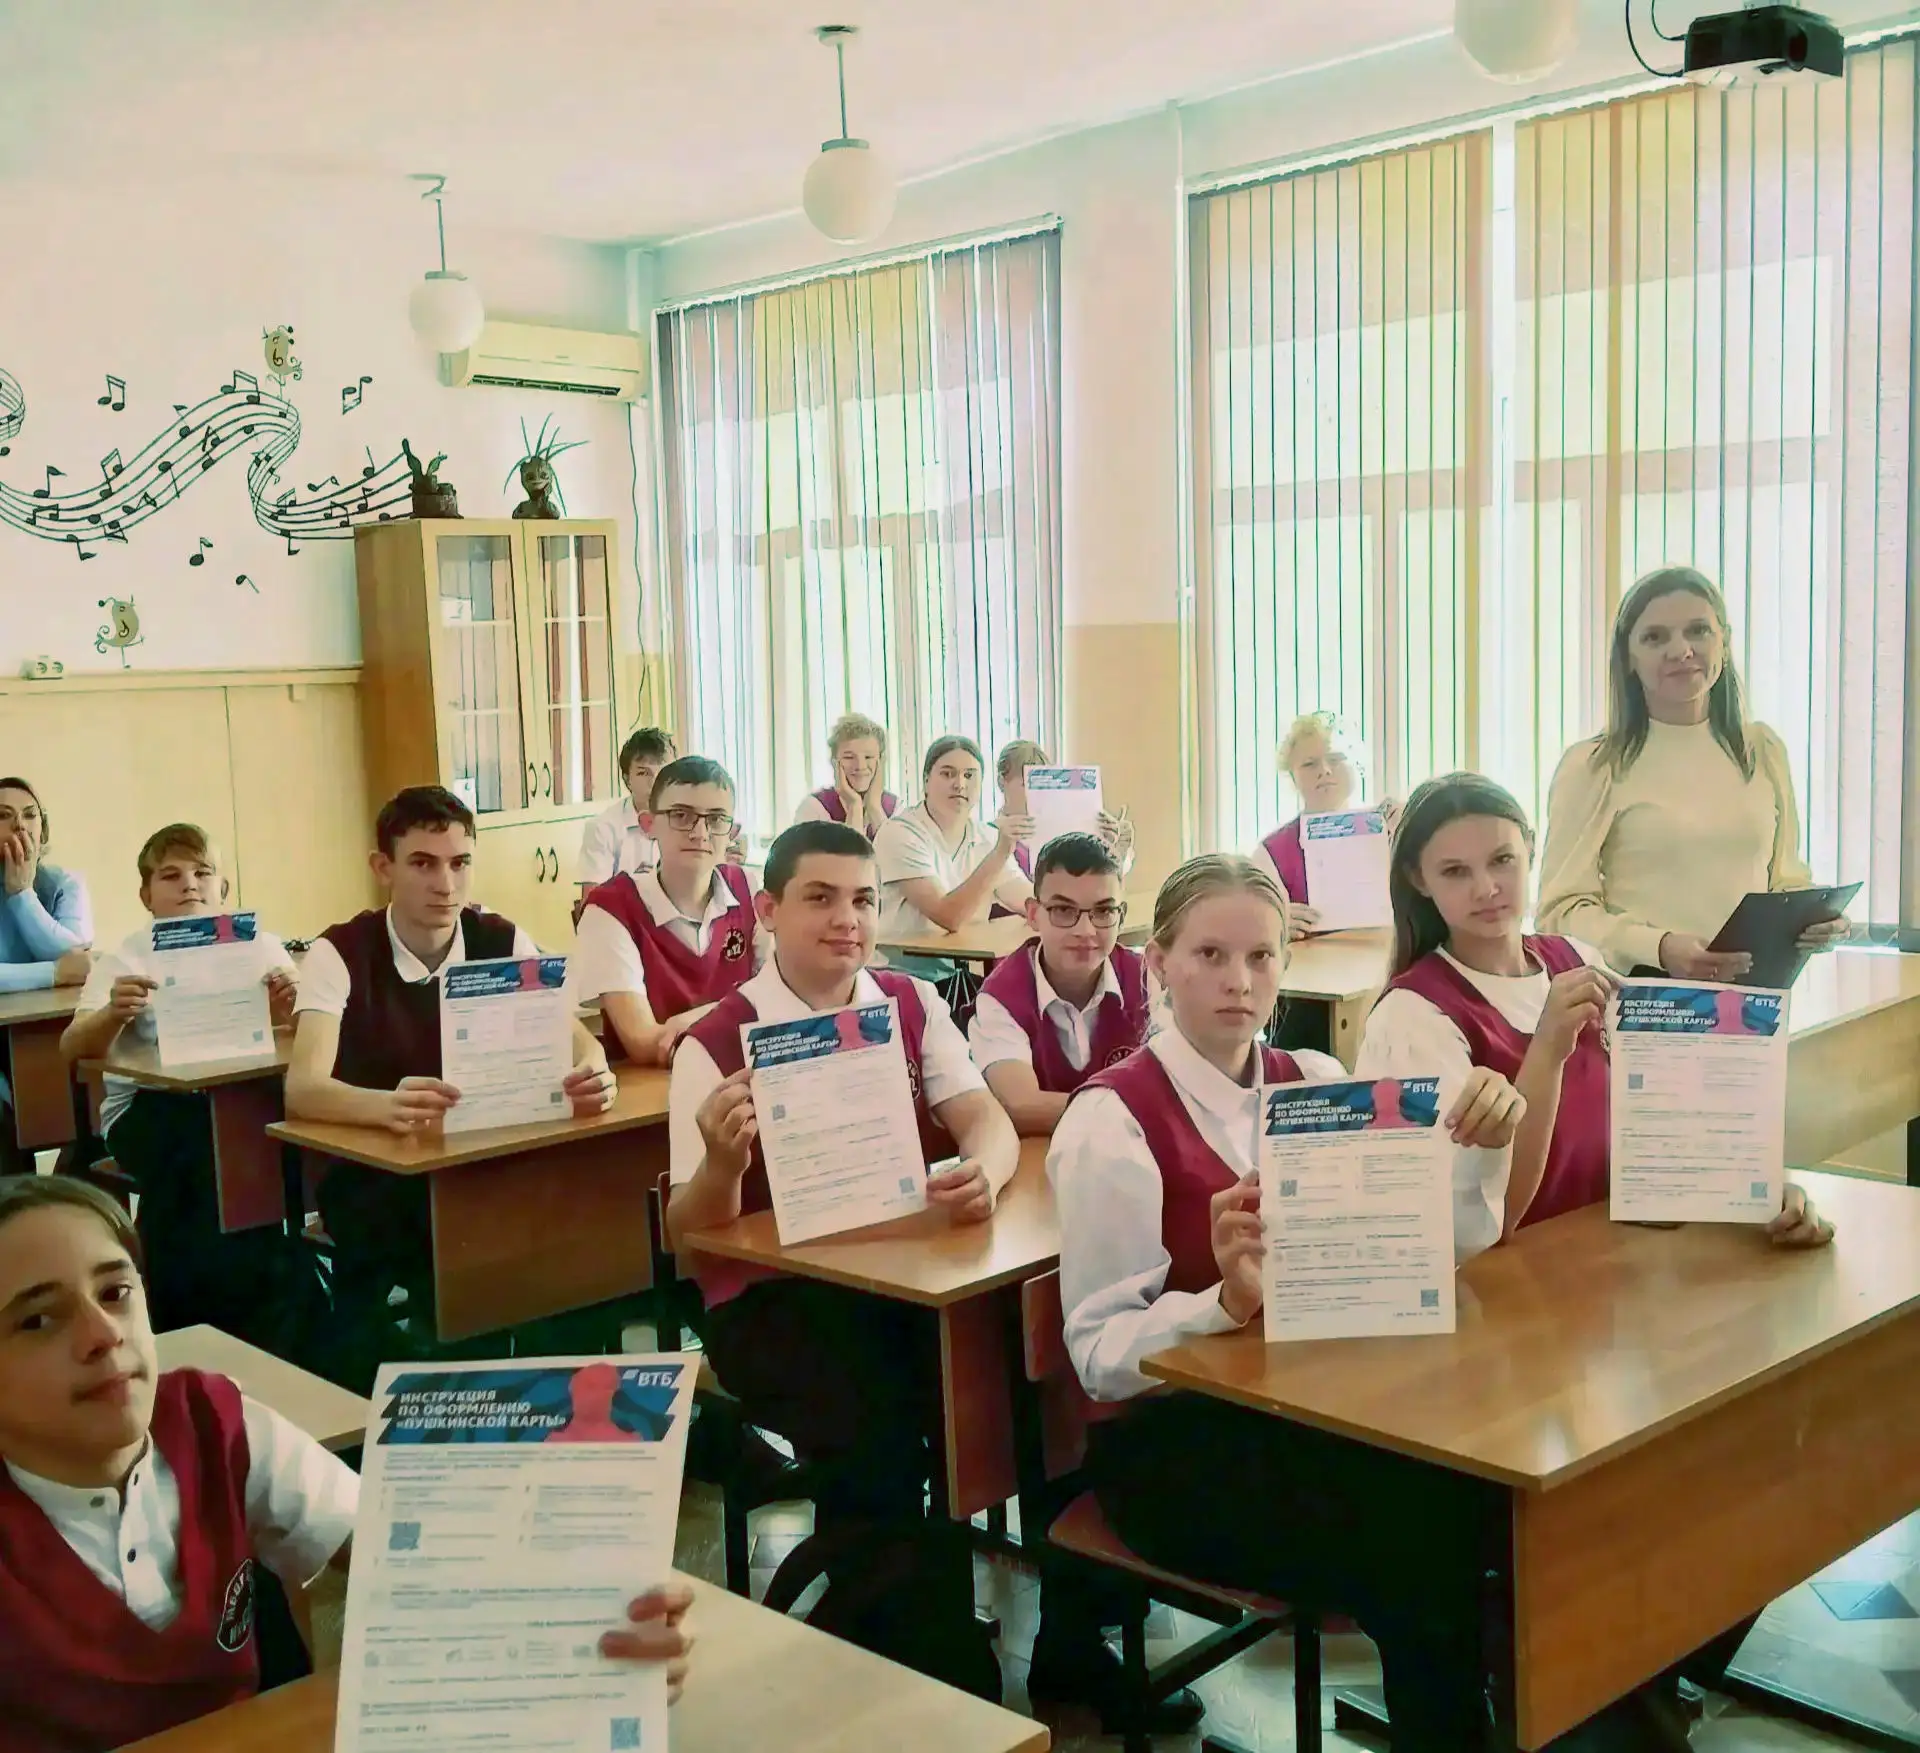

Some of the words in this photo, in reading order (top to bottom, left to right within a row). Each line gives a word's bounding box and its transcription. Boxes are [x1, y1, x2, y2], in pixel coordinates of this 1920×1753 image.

[1755, 999, 1776, 1008] ВТБ
[1413, 1082, 1434, 1093] ВТБ
[638, 1371, 673, 1387] ВТБ
[400, 1390, 496, 1403] ИНСТРУКЦИЯ
[398, 1404, 420, 1416] ПО
[423, 1402, 532, 1416] ОФОРМЛЕНИЮ
[396, 1414, 507, 1429] «ПУШКИНСКОЙ
[510, 1415, 566, 1428] КАРТЫ»
